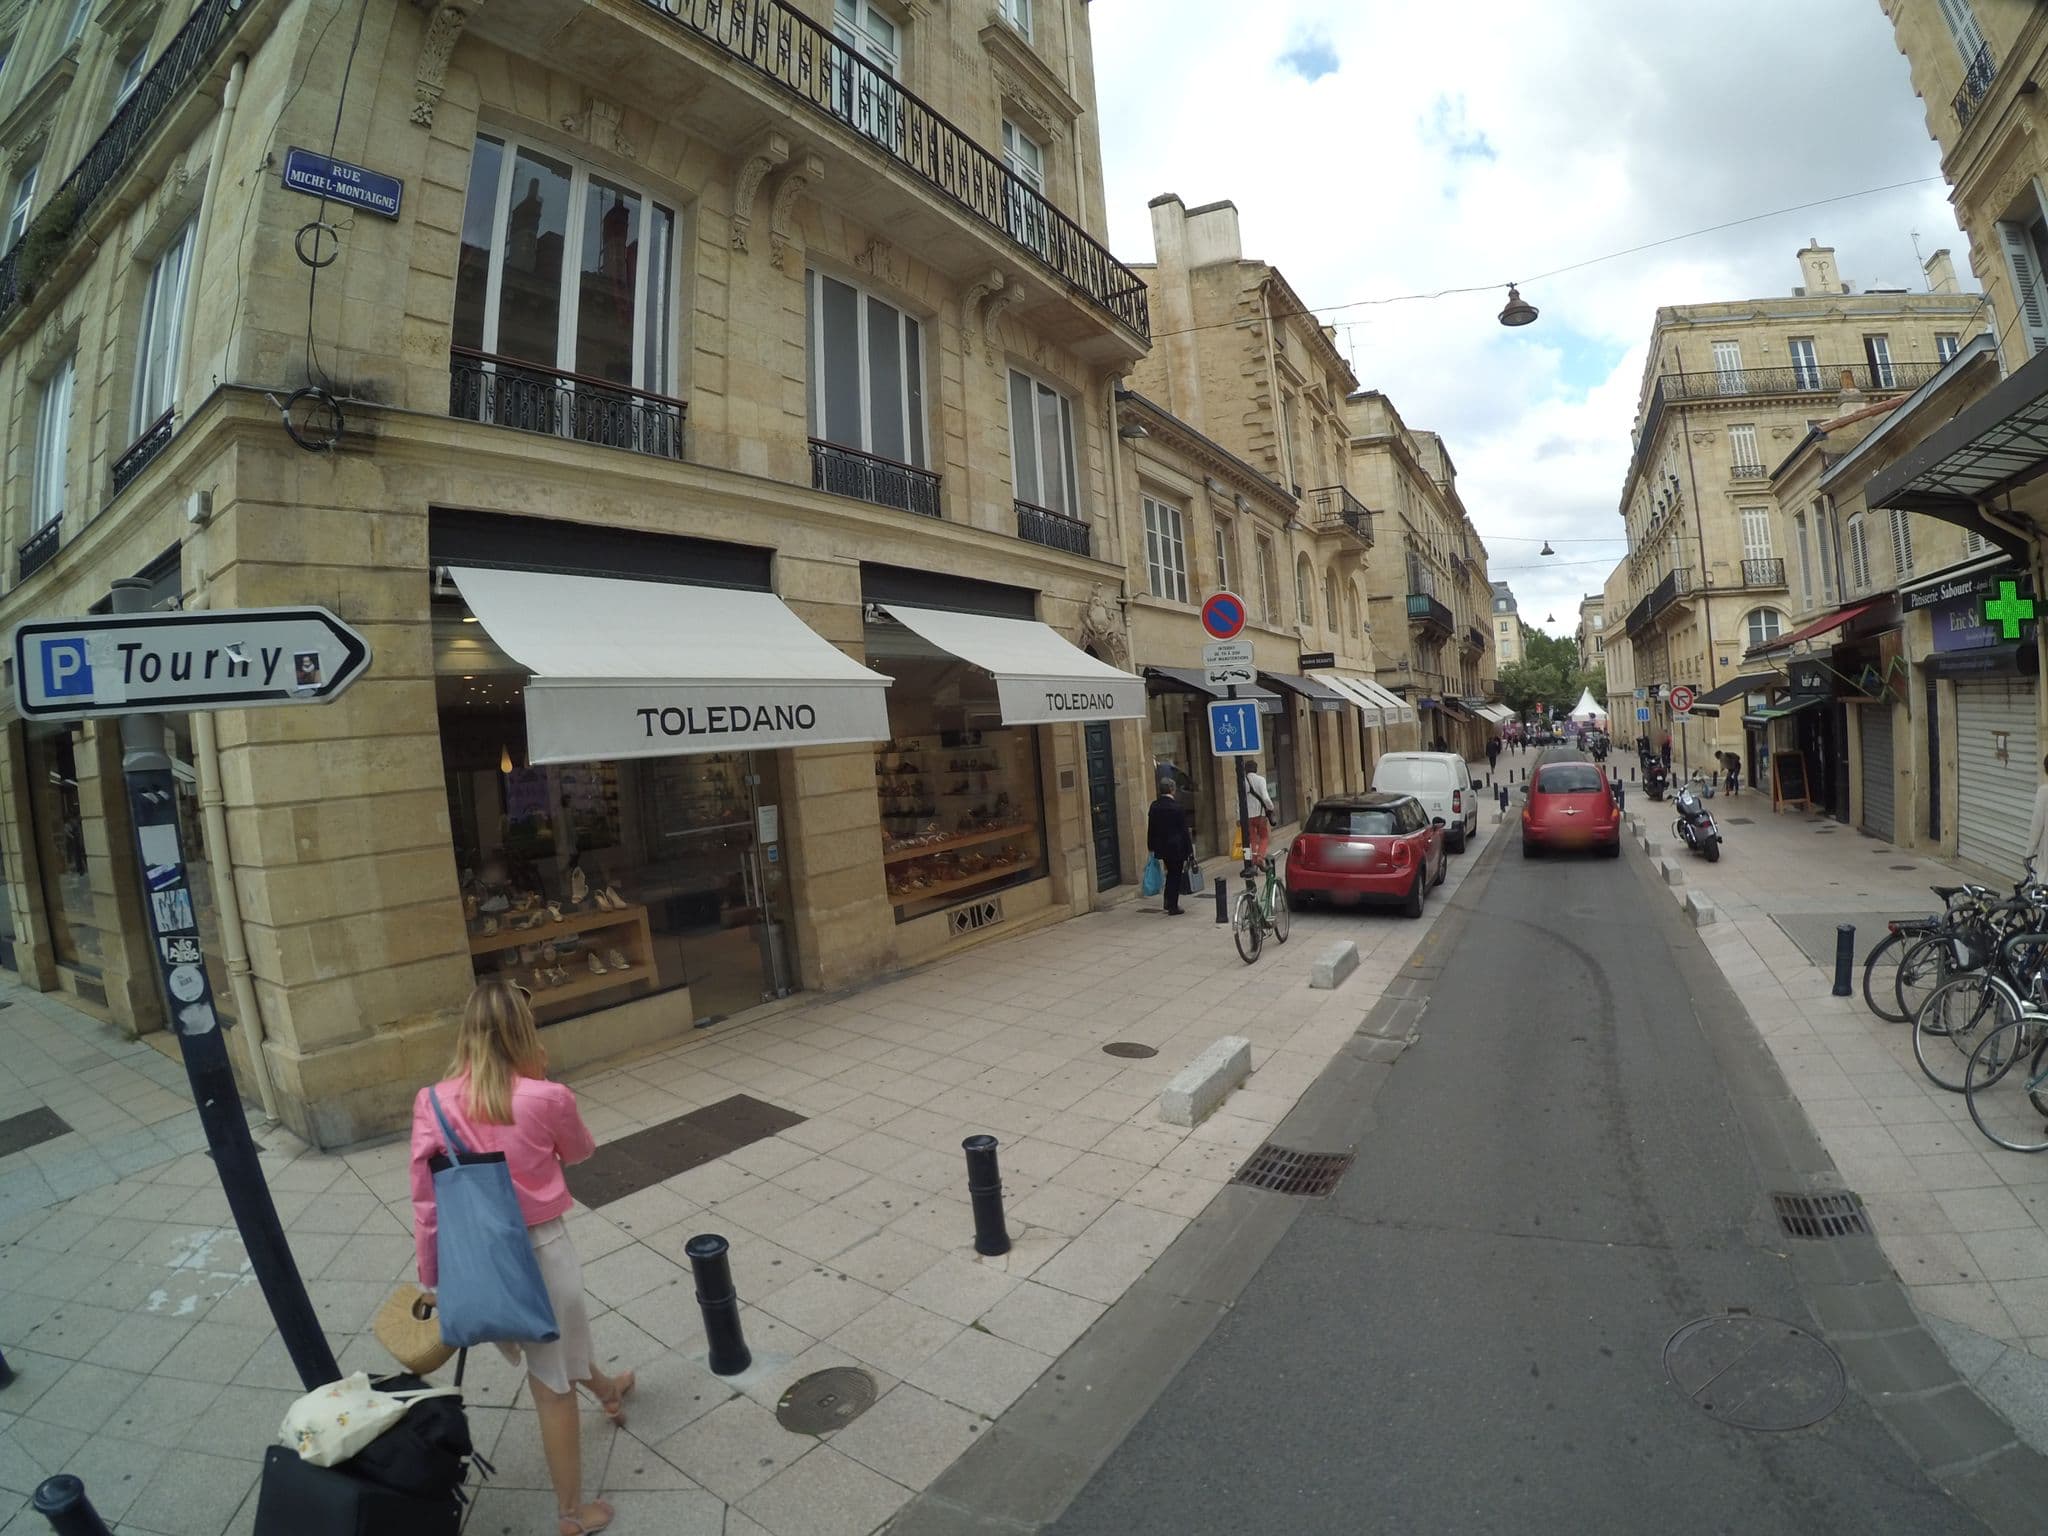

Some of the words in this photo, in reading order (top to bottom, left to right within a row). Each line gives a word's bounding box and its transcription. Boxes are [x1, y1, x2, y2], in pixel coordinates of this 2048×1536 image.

[332, 165, 361, 183] RUE
[290, 169, 396, 210] MICHEL-MONTAIGNE
[1940, 580, 1973, 600] Sabouret
[1950, 611, 1966, 631] Eric
[51, 646, 81, 690] P
[1045, 693, 1114, 711] TOLEDANO
[636, 704, 816, 737] TOLEDANO
